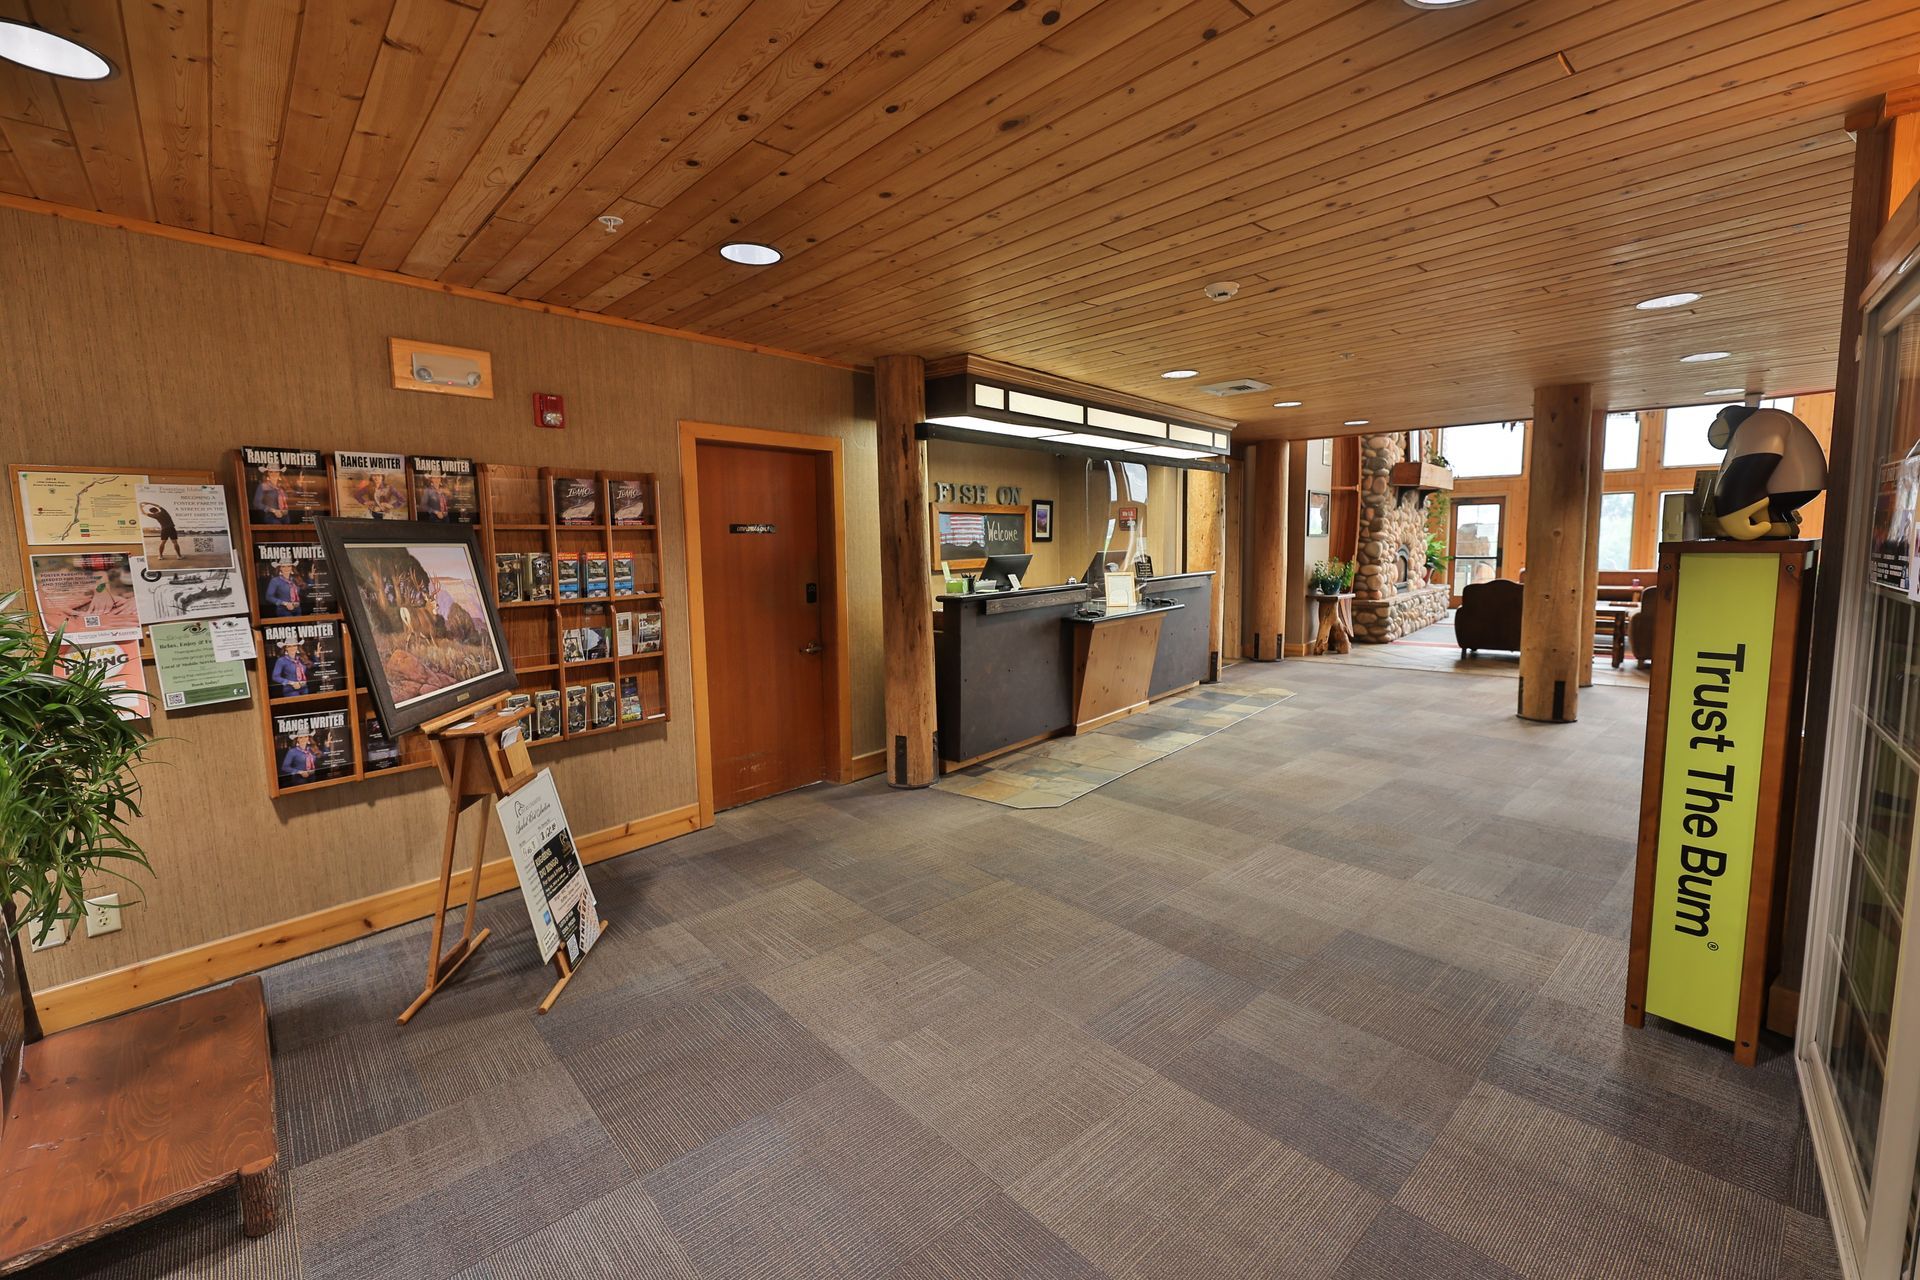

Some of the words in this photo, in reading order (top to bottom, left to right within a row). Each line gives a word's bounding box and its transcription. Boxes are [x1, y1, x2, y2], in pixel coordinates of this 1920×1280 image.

[247, 450, 280, 464] RANGE
[280, 452, 316, 466] WRITER
[340, 454, 368, 468] RANGE
[369, 457, 400, 470] WRITER
[415, 458, 440, 471] RANGE
[440, 460, 470, 472] WRITER
[934, 482, 988, 504] FISH
[996, 486, 1022, 505] ON
[987, 520, 1018, 542] Welcome
[260, 546, 292, 559] RANGE
[292, 546, 325, 559] WRITE
[266, 626, 297, 640] RANGE
[298, 624, 334, 638] WRITER
[1690, 644, 1746, 752] Trust
[279, 717, 309, 733] RANGE
[310, 714, 344, 729] WRITER
[1682, 764, 1735, 838] The
[1674, 844, 1727, 938] Bum
